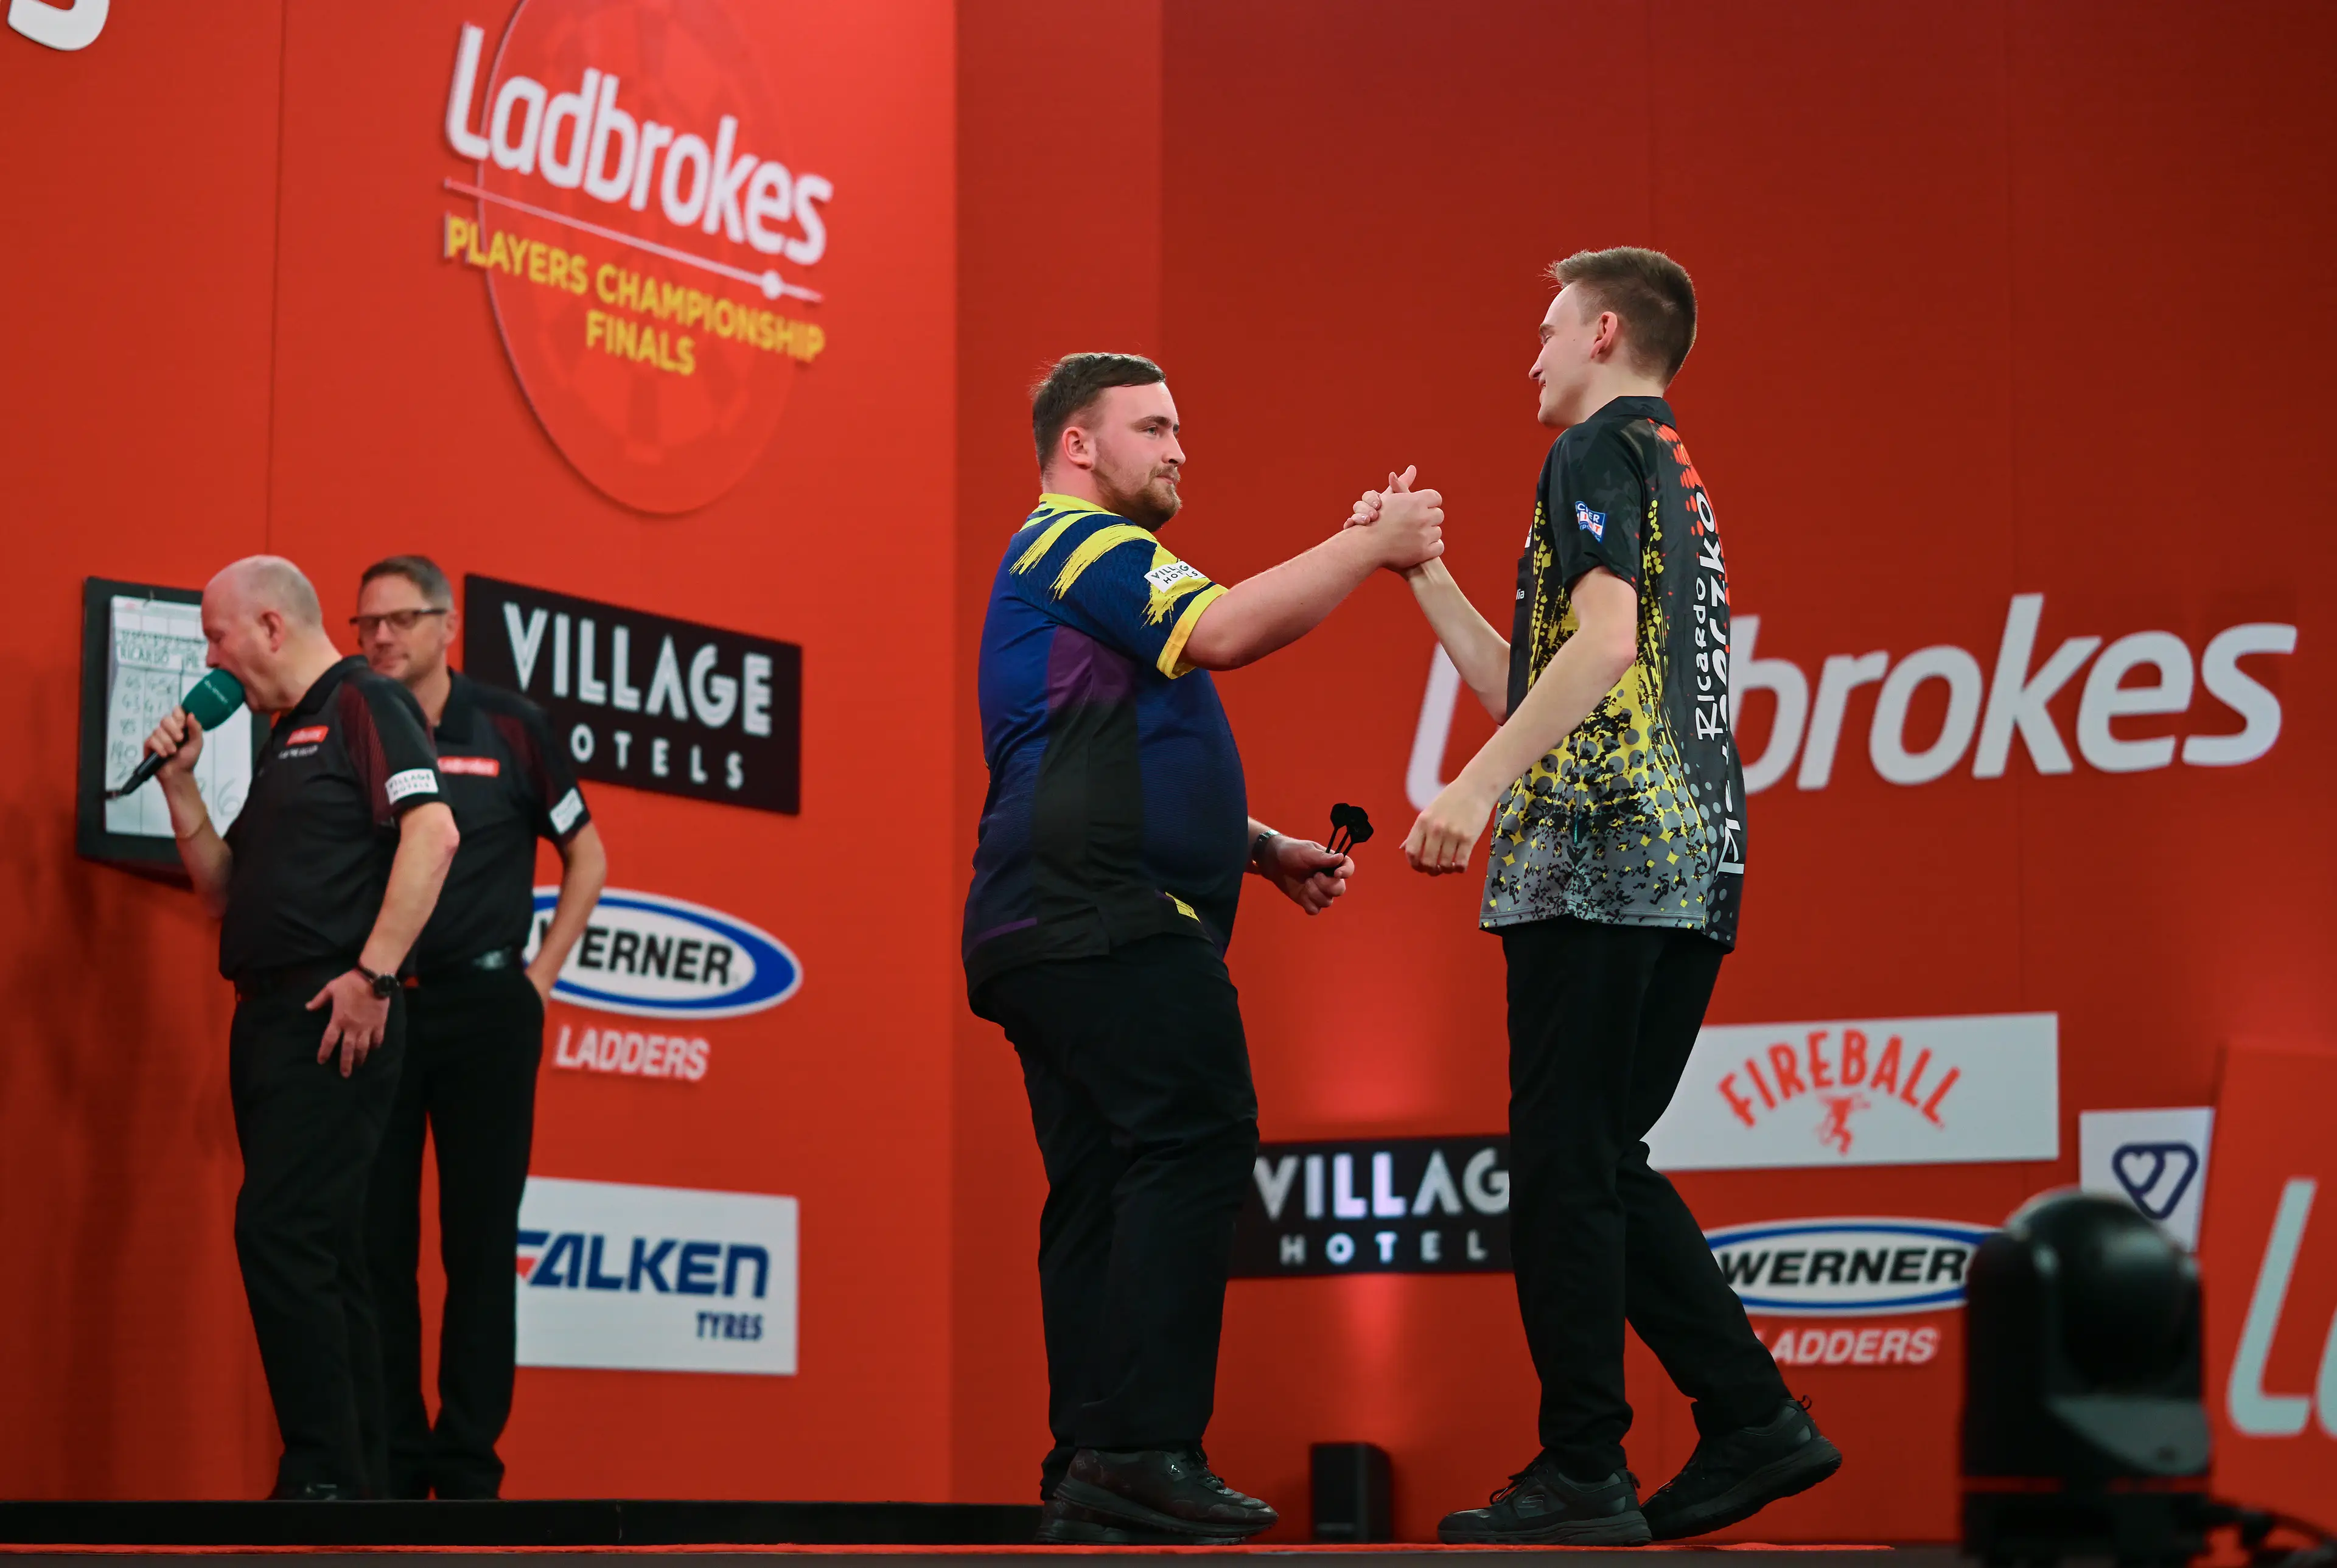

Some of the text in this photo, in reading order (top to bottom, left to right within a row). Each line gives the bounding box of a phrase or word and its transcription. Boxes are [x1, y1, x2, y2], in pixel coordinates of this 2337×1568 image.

[445, 21, 833, 266] Ladbrokes
[445, 213, 825, 363] PLAYERS CHAMPIONSHIP
[586, 308, 696, 377] FINALS
[503, 601, 772, 737] VILLAGE
[570, 723, 744, 790] OTELS
[540, 918, 733, 986] ERNER
[554, 1024, 711, 1081] LADDERS
[1717, 1029, 1961, 1130] FIREBALL
[1252, 1147, 1510, 1222] VILLAG
[516, 1228, 770, 1298] FALKEN
[1279, 1230, 1489, 1266] HOTEL
[1719, 1245, 1968, 1286] WERNER
[696, 1311, 764, 1342] TYRES
[2226, 1179, 2337, 1438] L
[1756, 1326, 1940, 1367] ADDERS
